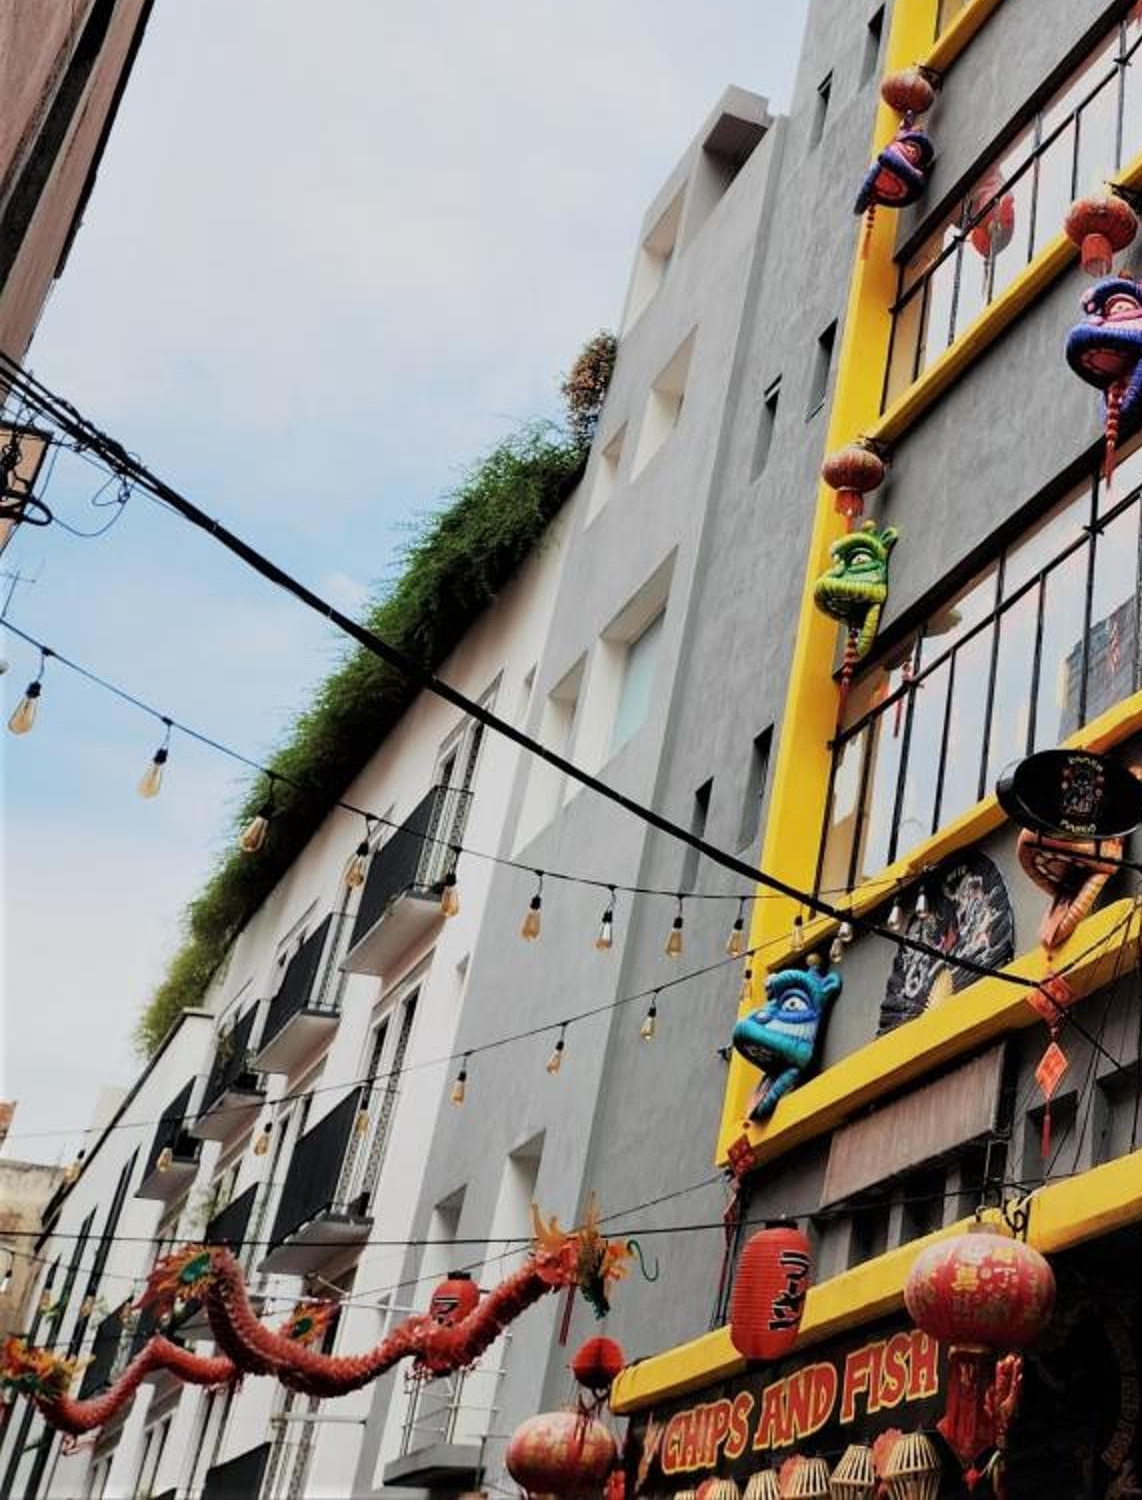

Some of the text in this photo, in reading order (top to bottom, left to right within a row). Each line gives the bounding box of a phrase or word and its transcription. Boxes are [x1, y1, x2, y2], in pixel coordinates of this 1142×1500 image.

[661, 1329, 940, 1475] CHIPS AND FISH
